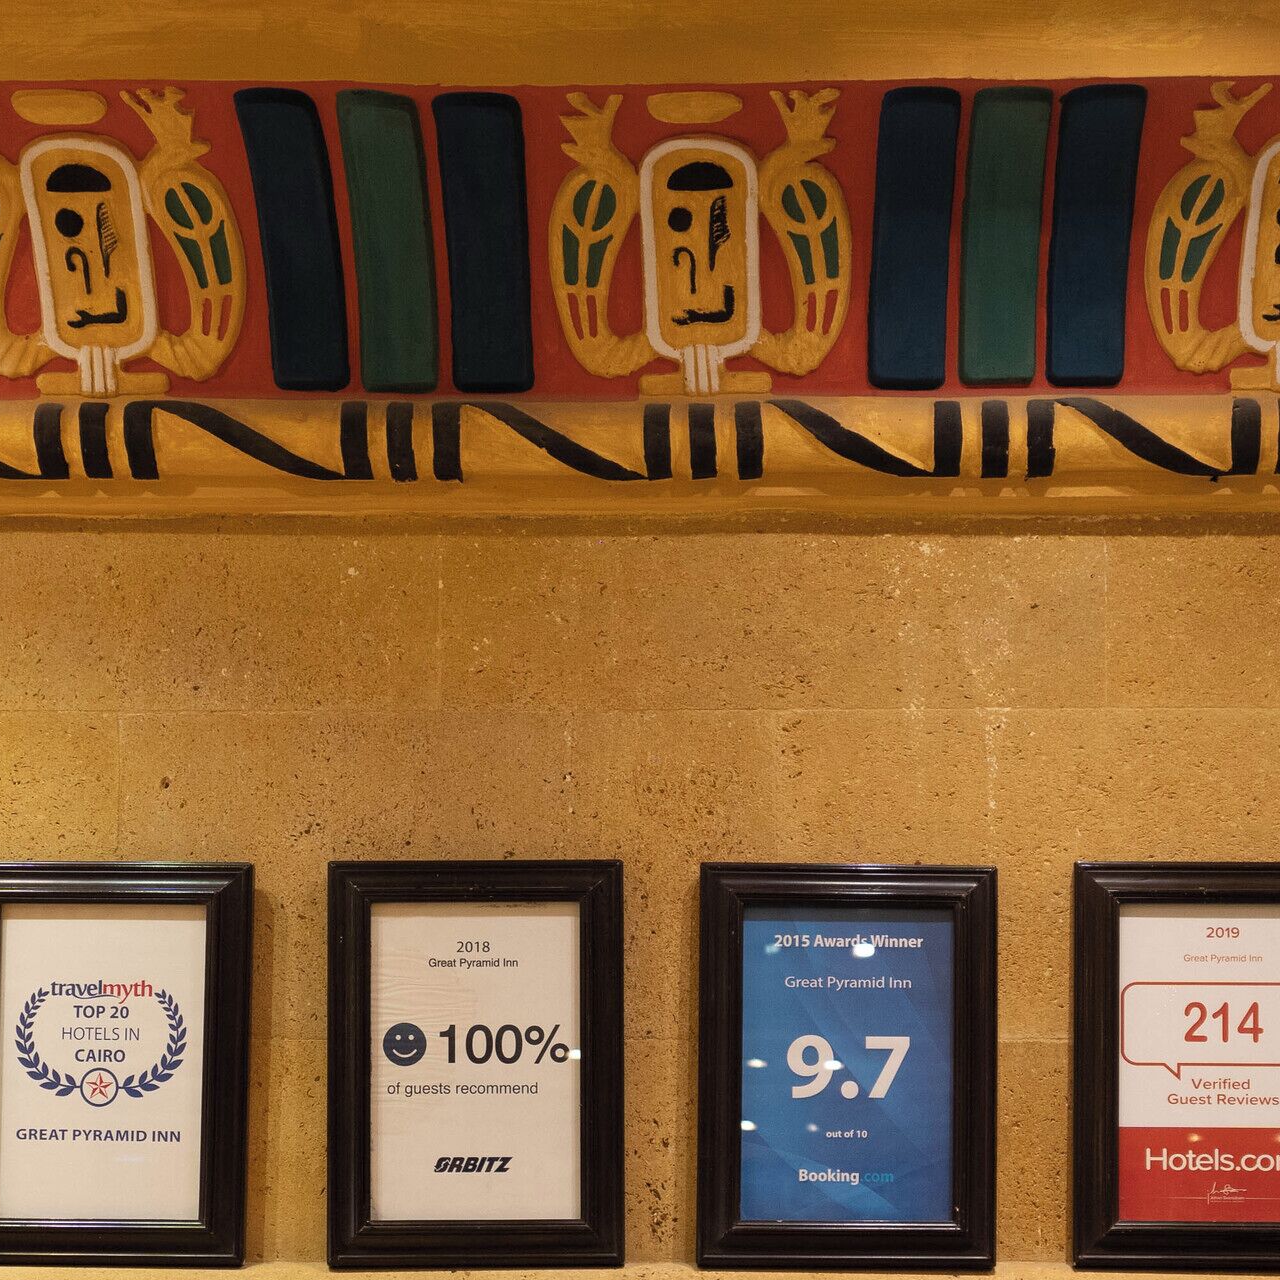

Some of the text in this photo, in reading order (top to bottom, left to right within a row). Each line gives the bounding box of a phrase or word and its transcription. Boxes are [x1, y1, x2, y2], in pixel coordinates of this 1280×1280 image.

[1206, 926, 1240, 939] 2019
[456, 941, 490, 953] 2018
[774, 934, 924, 948] 2015 Awards Winner
[428, 958, 518, 970] Great Pyramid Inn
[1183, 954, 1263, 964] Great Pyramid Inn
[784, 976, 912, 991] Great Pyramid Inn
[50, 980, 153, 1004] travelmyth
[73, 1005, 130, 1019] TOP 20
[1184, 1001, 1264, 1044] 214
[61, 1027, 140, 1041] HOTELS IN
[439, 1024, 570, 1065] 100%
[74, 1049, 126, 1062] CAIRO
[786, 1034, 911, 1100] 9.7
[387, 1082, 538, 1098] of guests recommend
[1191, 1078, 1251, 1090] Verified
[1167, 1094, 1280, 1106] Guest Reviews
[16, 1128, 181, 1143] GREAT PYRAMID INN
[844, 1129, 855, 1138] of
[856, 1130, 868, 1138] 10
[433, 1156, 513, 1173] ORBITZ
